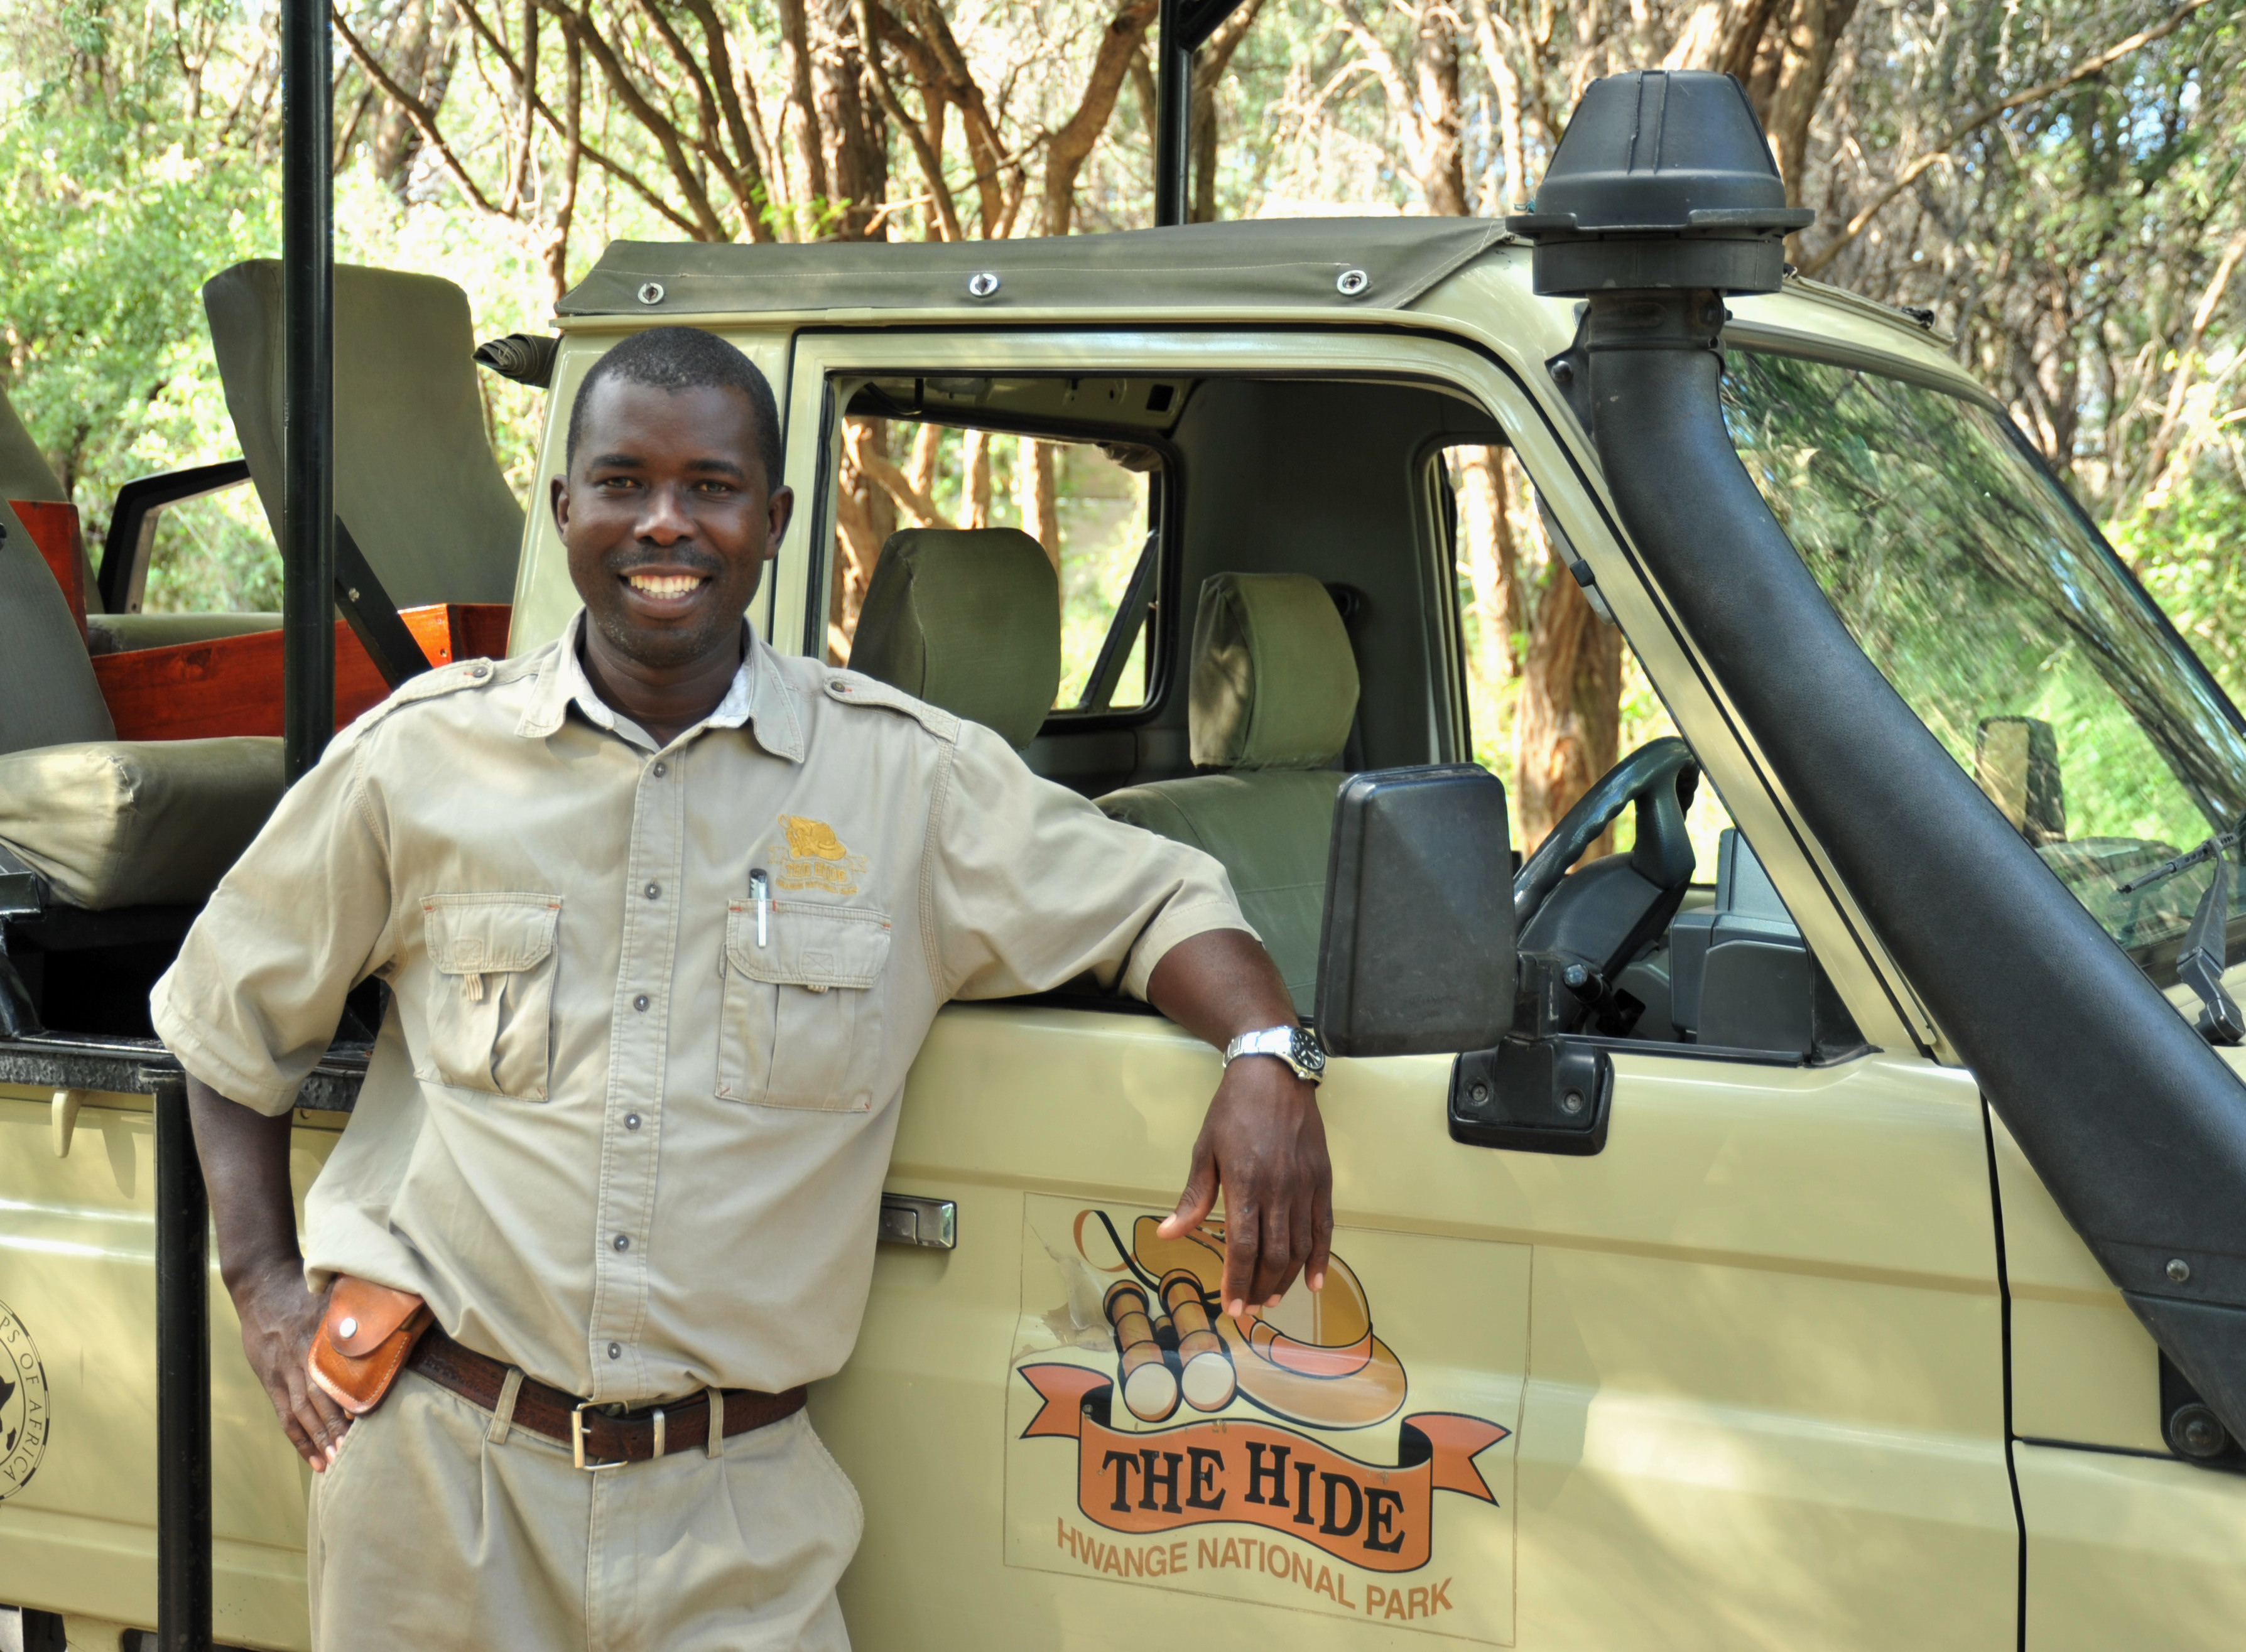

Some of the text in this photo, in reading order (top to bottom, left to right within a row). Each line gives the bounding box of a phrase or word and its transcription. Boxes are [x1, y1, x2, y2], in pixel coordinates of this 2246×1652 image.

[786, 862, 847, 882] THE HIDE
[20, 1352, 40, 1385] OF
[5, 1399, 43, 1482] AFRICA
[1102, 1441, 1405, 1553] THE HIDE
[1058, 1516, 1453, 1620] HWANGE NATIONAL PARK
